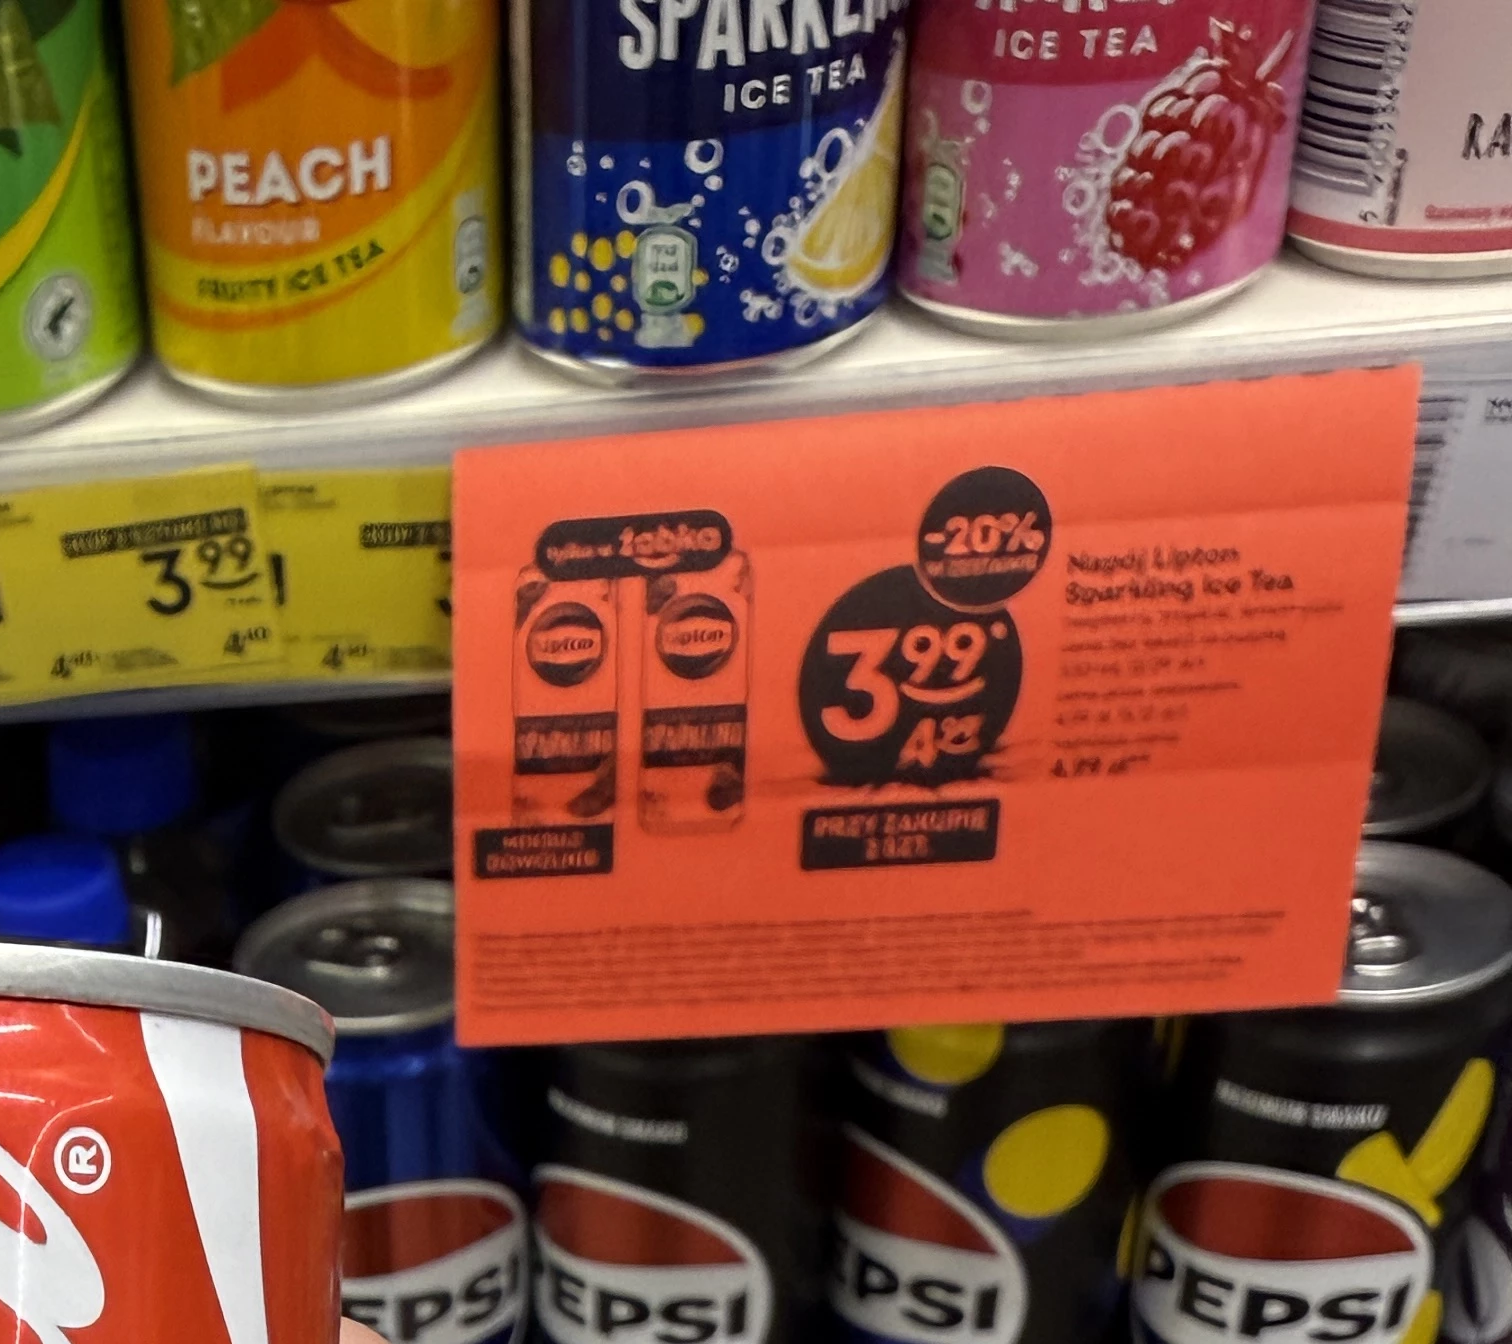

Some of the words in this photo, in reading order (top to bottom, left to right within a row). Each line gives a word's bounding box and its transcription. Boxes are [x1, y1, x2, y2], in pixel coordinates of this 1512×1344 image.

[994, 28, 1059, 61] ICE
[1078, 25, 1158, 60] TEA
[723, 75, 791, 113] ICE
[806, 53, 866, 96] TEA
[187, 135, 392, 206] PEACH
[924, 511, 1045, 556] -20%
[342, 1256, 522, 1342] EPSI
[835, 1241, 1001, 1332] PSI
[1145, 1241, 1414, 1344] PEPSI
